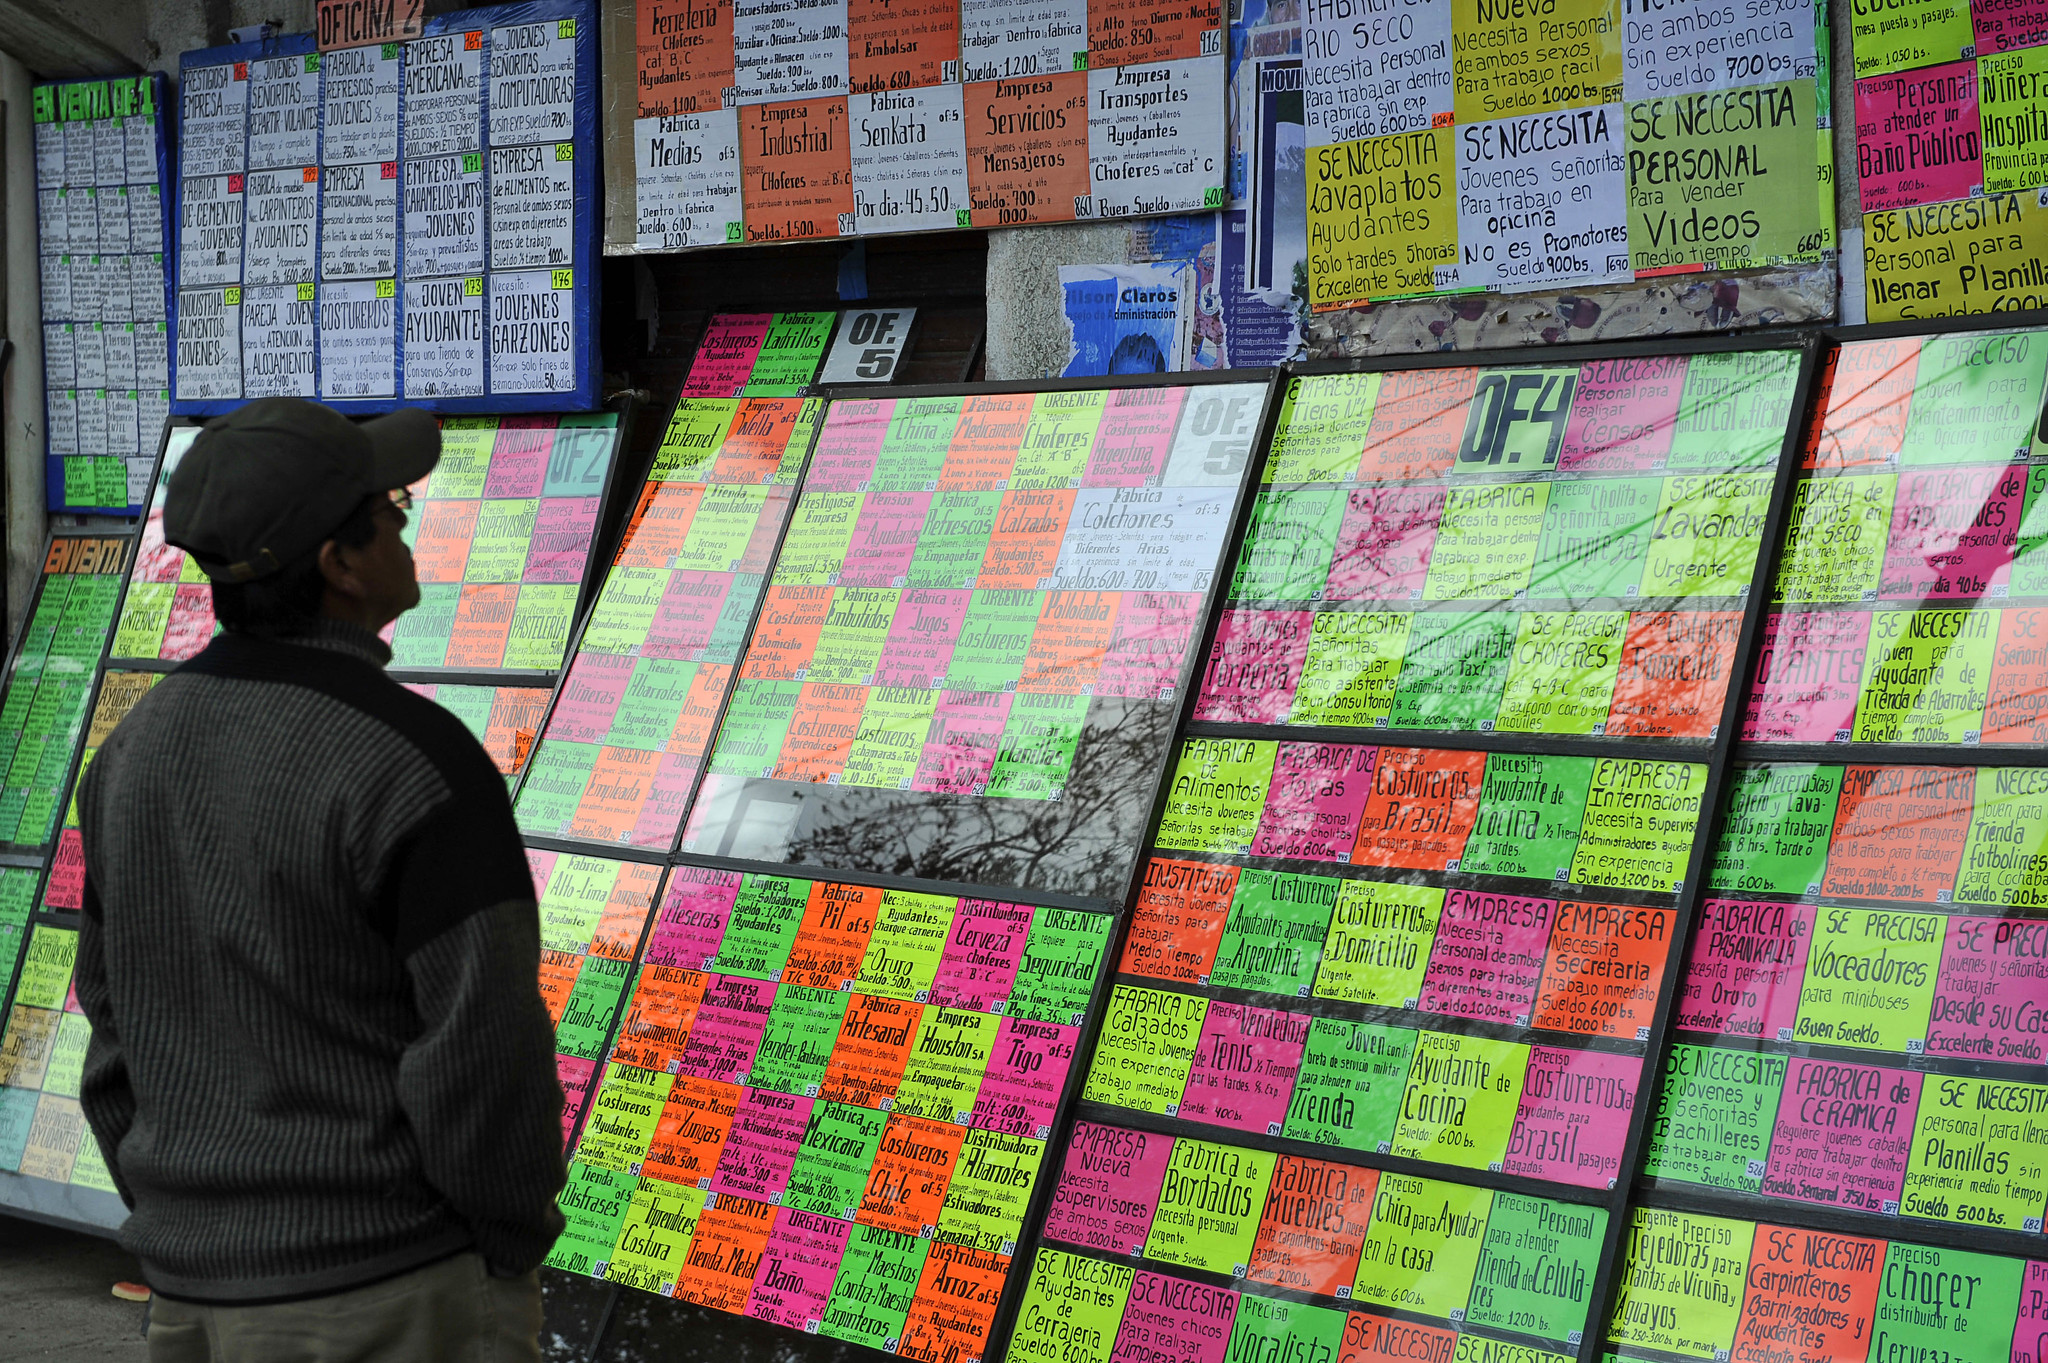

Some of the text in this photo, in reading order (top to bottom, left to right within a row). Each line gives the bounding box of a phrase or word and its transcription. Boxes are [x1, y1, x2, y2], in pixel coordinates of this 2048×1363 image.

[321, 2, 394, 45] OFICINA
[1306, 29, 1341, 59] RIO
[1353, 14, 1413, 48] SECO
[1454, 17, 1613, 52] Necesita Personal
[1627, 7, 1734, 44] De ambos
[1881, 14, 1909, 35] puesta
[405, 39, 454, 67] EMPRESA
[866, 41, 918, 58] Embolsar
[1666, 20, 1793, 61] experiencia
[327, 51, 365, 76] FABRICA
[491, 52, 538, 78] SEÑORITAS
[1115, 67, 1170, 86] Empresa
[1305, 41, 1445, 86] Necesita Personal
[1493, 67, 1554, 88] trabajo
[326, 78, 374, 99] REFRESCOS
[405, 63, 464, 95] AMERICANA
[499, 76, 573, 109] COMPUTADORAS
[890, 71, 910, 89] 680
[995, 81, 1052, 100] Empresa
[1262, 68, 1303, 91] MOVI
[1407, 70, 1450, 89] dentro
[1897, 70, 1973, 109] Personal
[1099, 84, 1189, 110] Transportes
[328, 100, 372, 126] JOVENES
[659, 116, 700, 133] Fabrica
[986, 104, 1067, 135] Servicios
[1325, 106, 1370, 128] fabrica
[1630, 86, 1796, 142] SE NECESITA
[1884, 108, 1936, 133] atender
[760, 119, 833, 158] Industrial
[1107, 126, 1177, 146] Ayudantes
[1464, 110, 1610, 161] SE NECESITA
[650, 137, 702, 167] Medias
[984, 153, 1065, 178] Mensajeros
[1319, 133, 1438, 181] SE NECESITA
[1629, 145, 1767, 185] PERSONAL
[1857, 126, 1979, 178] Baño Público
[1096, 161, 1160, 181] Choferes
[1460, 150, 1626, 191] Jovenes Señoritas
[905, 188, 922, 212] 45
[930, 186, 949, 211] 50
[1099, 196, 1169, 217] Buen Sueldo
[1312, 208, 1429, 253] Ayudantes
[1487, 209, 1556, 237] oficina
[1643, 207, 1760, 247] Videos
[1873, 194, 2021, 242] SE NECESITA
[1508, 242, 1531, 258] es
[1544, 224, 1628, 254] Promotores
[1690, 243, 1750, 264] tiempo
[1865, 233, 2023, 270] Personal para
[1312, 255, 1342, 274] Solo
[1347, 249, 1396, 271] tardes
[422, 283, 463, 307] JOVEN
[1121, 289, 1177, 303] Claros
[1872, 277, 1940, 303] llenar
[495, 292, 559, 321] JOVENES
[405, 309, 481, 342] AYUDANTE
[493, 321, 570, 354] GARZONES
[763, 326, 821, 350] Ladrillos
[856, 349, 895, 379] 5
[662, 424, 720, 448] Internet
[1581, 422, 1655, 442] Censos
[1449, 488, 1535, 510] FABRICA
[1082, 507, 1174, 529] Colchones
[1652, 558, 1727, 583] Urgente
[1531, 615, 1626, 637] SE PRECISA
[1337, 677, 1394, 691] asistente
[1870, 663, 1945, 688] Ayudante
[1183, 741, 1255, 764] FABRICA
[1174, 776, 1260, 802] Alimentos
[1486, 778, 1563, 805] Ayudante de
[1381, 802, 1452, 835] Brasil
[1556, 903, 1665, 940] EMPRESA
[1828, 913, 1939, 943] SE PRECISA
[955, 927, 1013, 952] Cerveza
[1334, 931, 1418, 969] Domicilio
[1023, 943, 1100, 982] Seguridad
[1555, 955, 1650, 980] Secretaria
[1814, 939, 1928, 988] Voceadores
[1113, 986, 1204, 1020] FABRICA DE
[1802, 987, 1910, 1011] para minibuses
[843, 1011, 906, 1046] Artesanal
[1004, 1038, 1042, 1073] Tigo
[1291, 1086, 1354, 1130] Tienda
[1404, 1088, 1466, 1126] Cocina
[1799, 1097, 1898, 1133] CERAMICA
[801, 1120, 866, 1159] Mexicana
[1923, 1139, 2009, 1175] Planillas
[943, 1194, 1001, 1218] Estivadores
[1055, 1183, 1147, 1219] Supervisores
[1166, 1166, 1251, 1217] Bordados
[1749, 1268, 1851, 1304] Carpinteros
[1024, 1304, 1101, 1349] Cerrajeria
